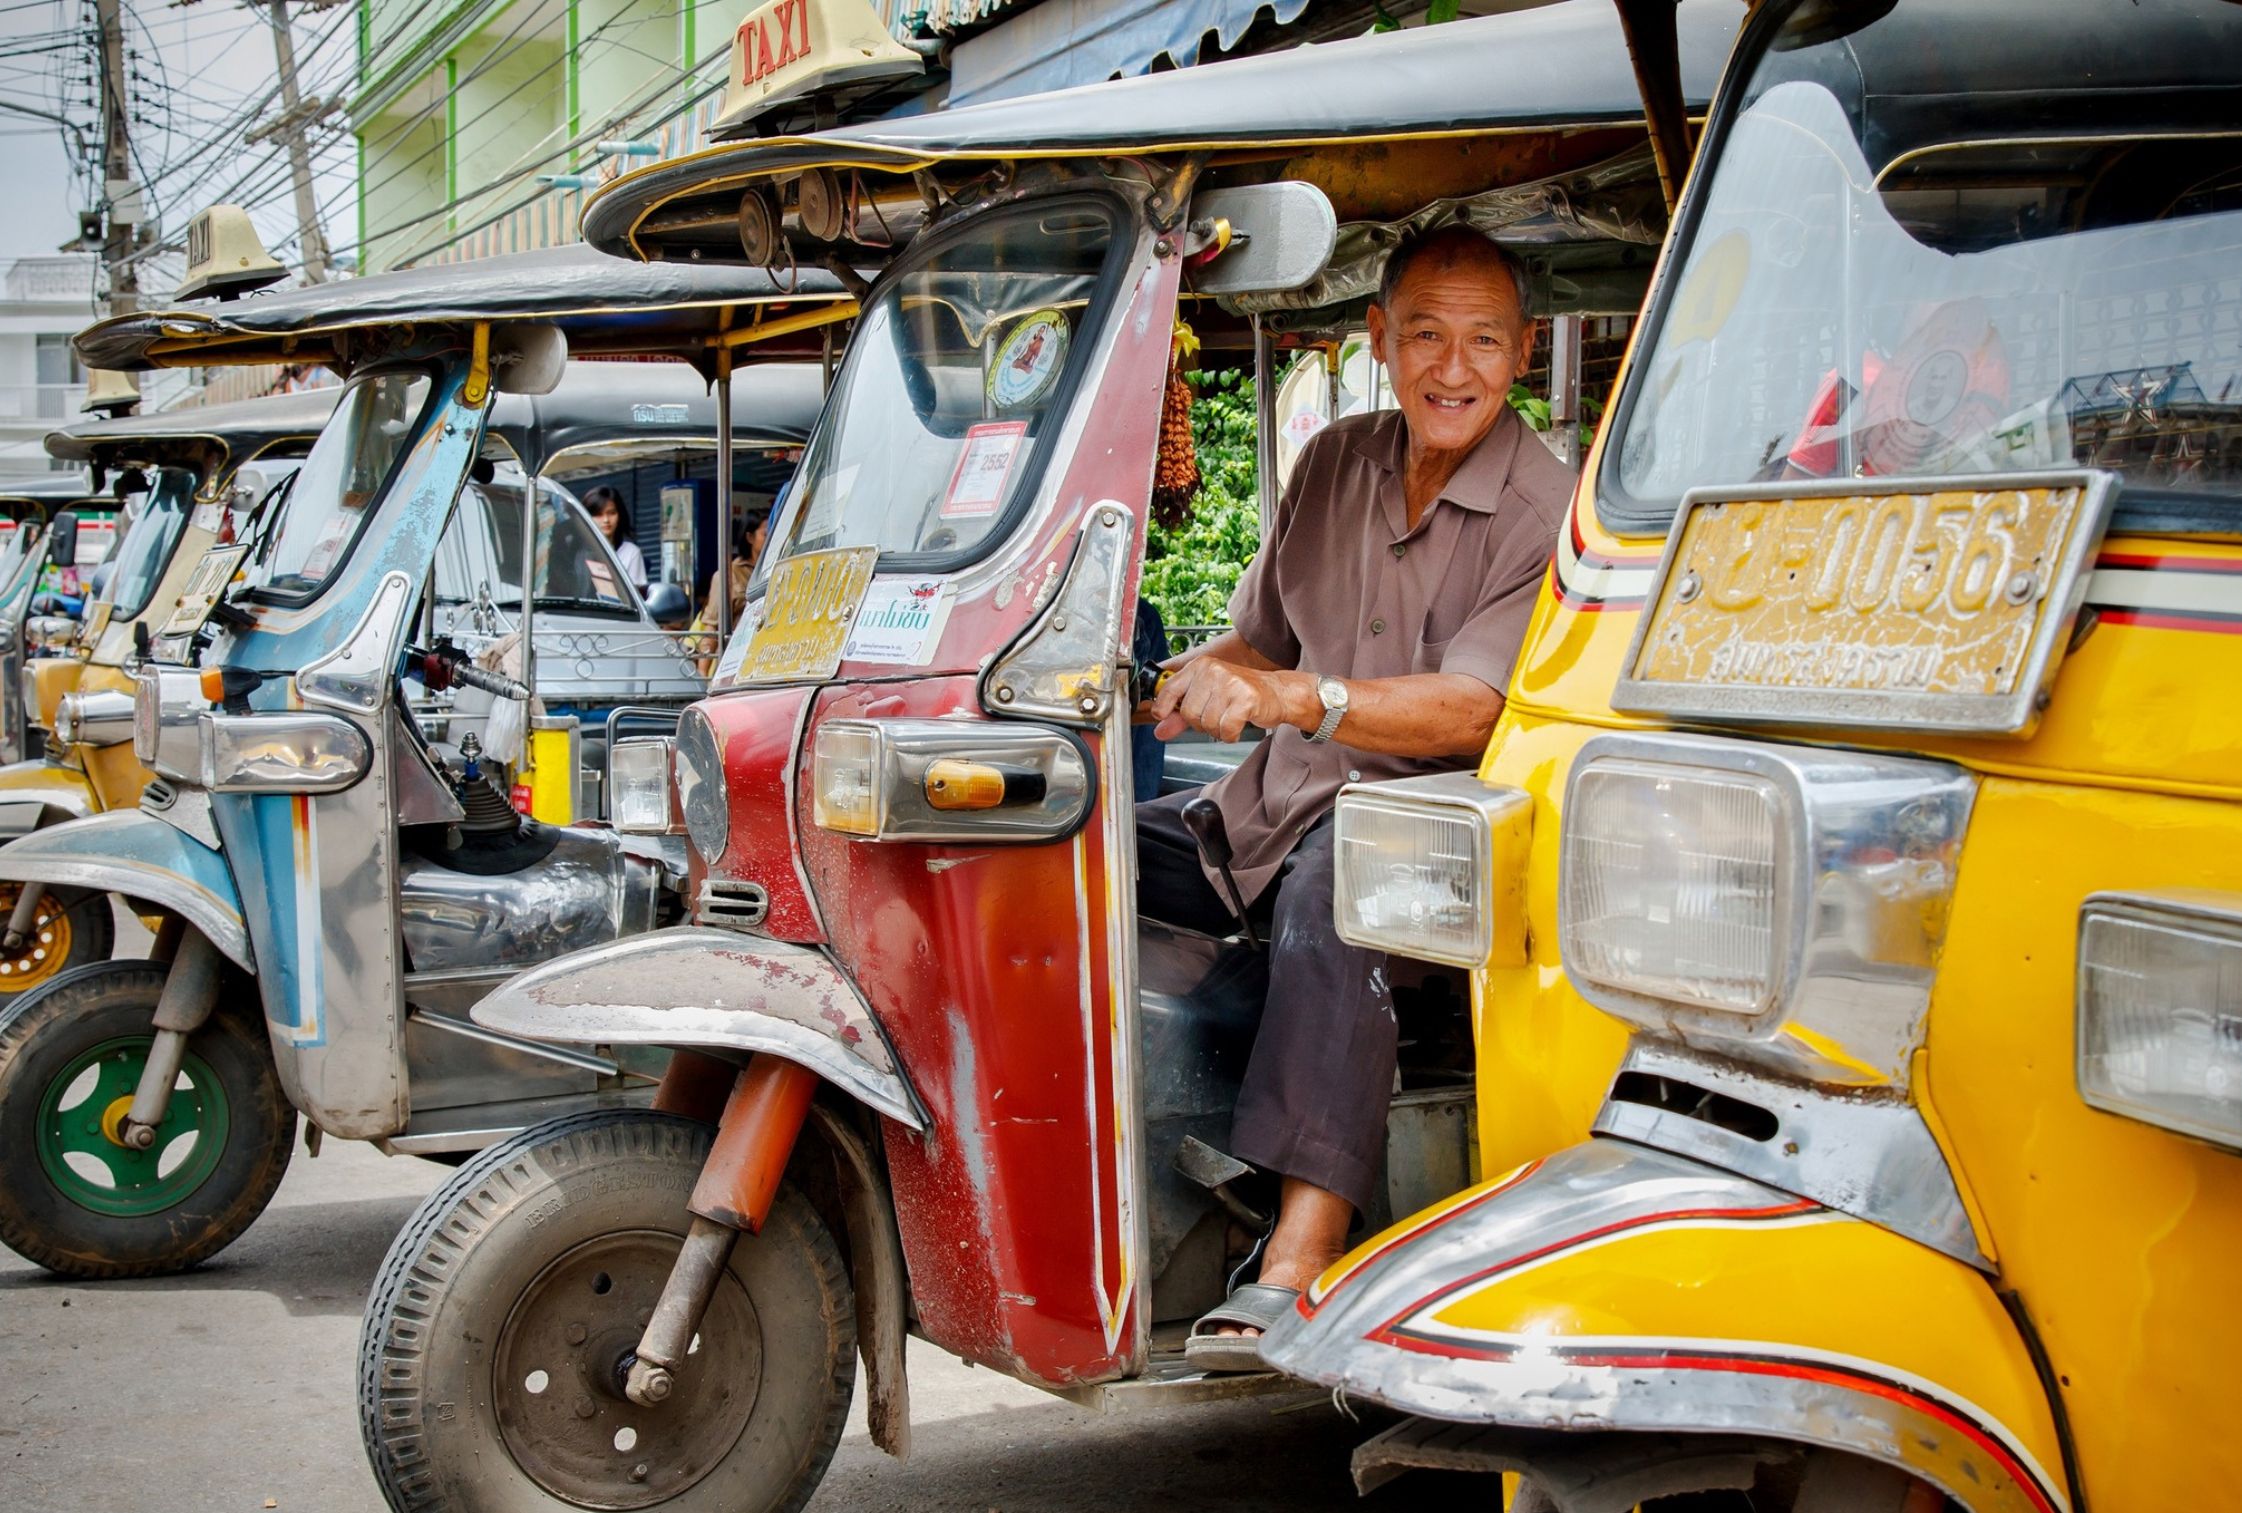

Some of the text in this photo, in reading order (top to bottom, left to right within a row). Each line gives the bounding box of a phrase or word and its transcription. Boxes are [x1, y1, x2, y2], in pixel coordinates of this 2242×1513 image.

[738, 0, 811, 86] TAXI
[980, 453, 1010, 472] 2552
[525, 1172, 694, 1229] BRIDGESTON
